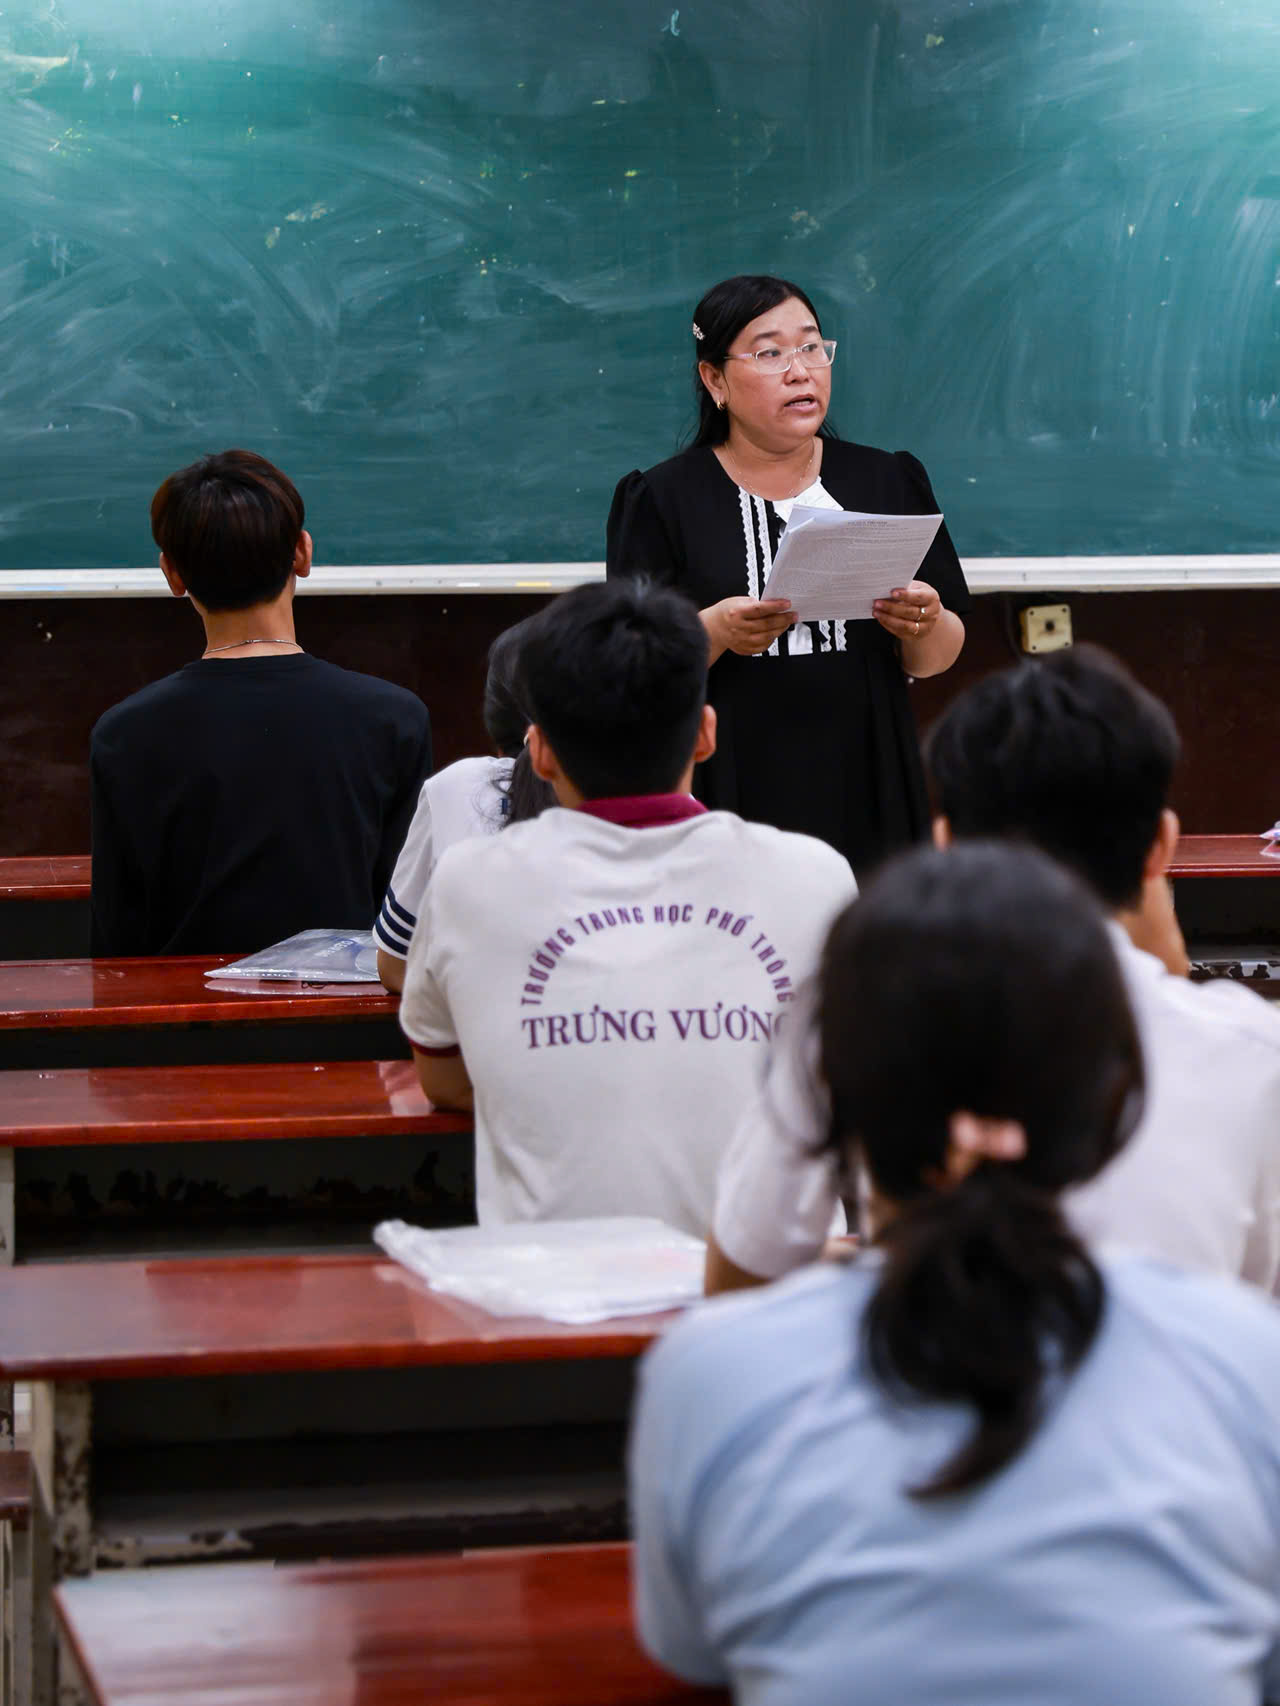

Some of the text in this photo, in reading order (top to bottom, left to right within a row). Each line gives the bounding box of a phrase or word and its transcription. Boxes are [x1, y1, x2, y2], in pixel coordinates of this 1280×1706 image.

[520, 927, 576, 1006] TRƯỜNG
[575, 905, 644, 935] TRUNG
[653, 903, 693, 926] HỌC
[521, 1003, 656, 1049] TRƯNG
